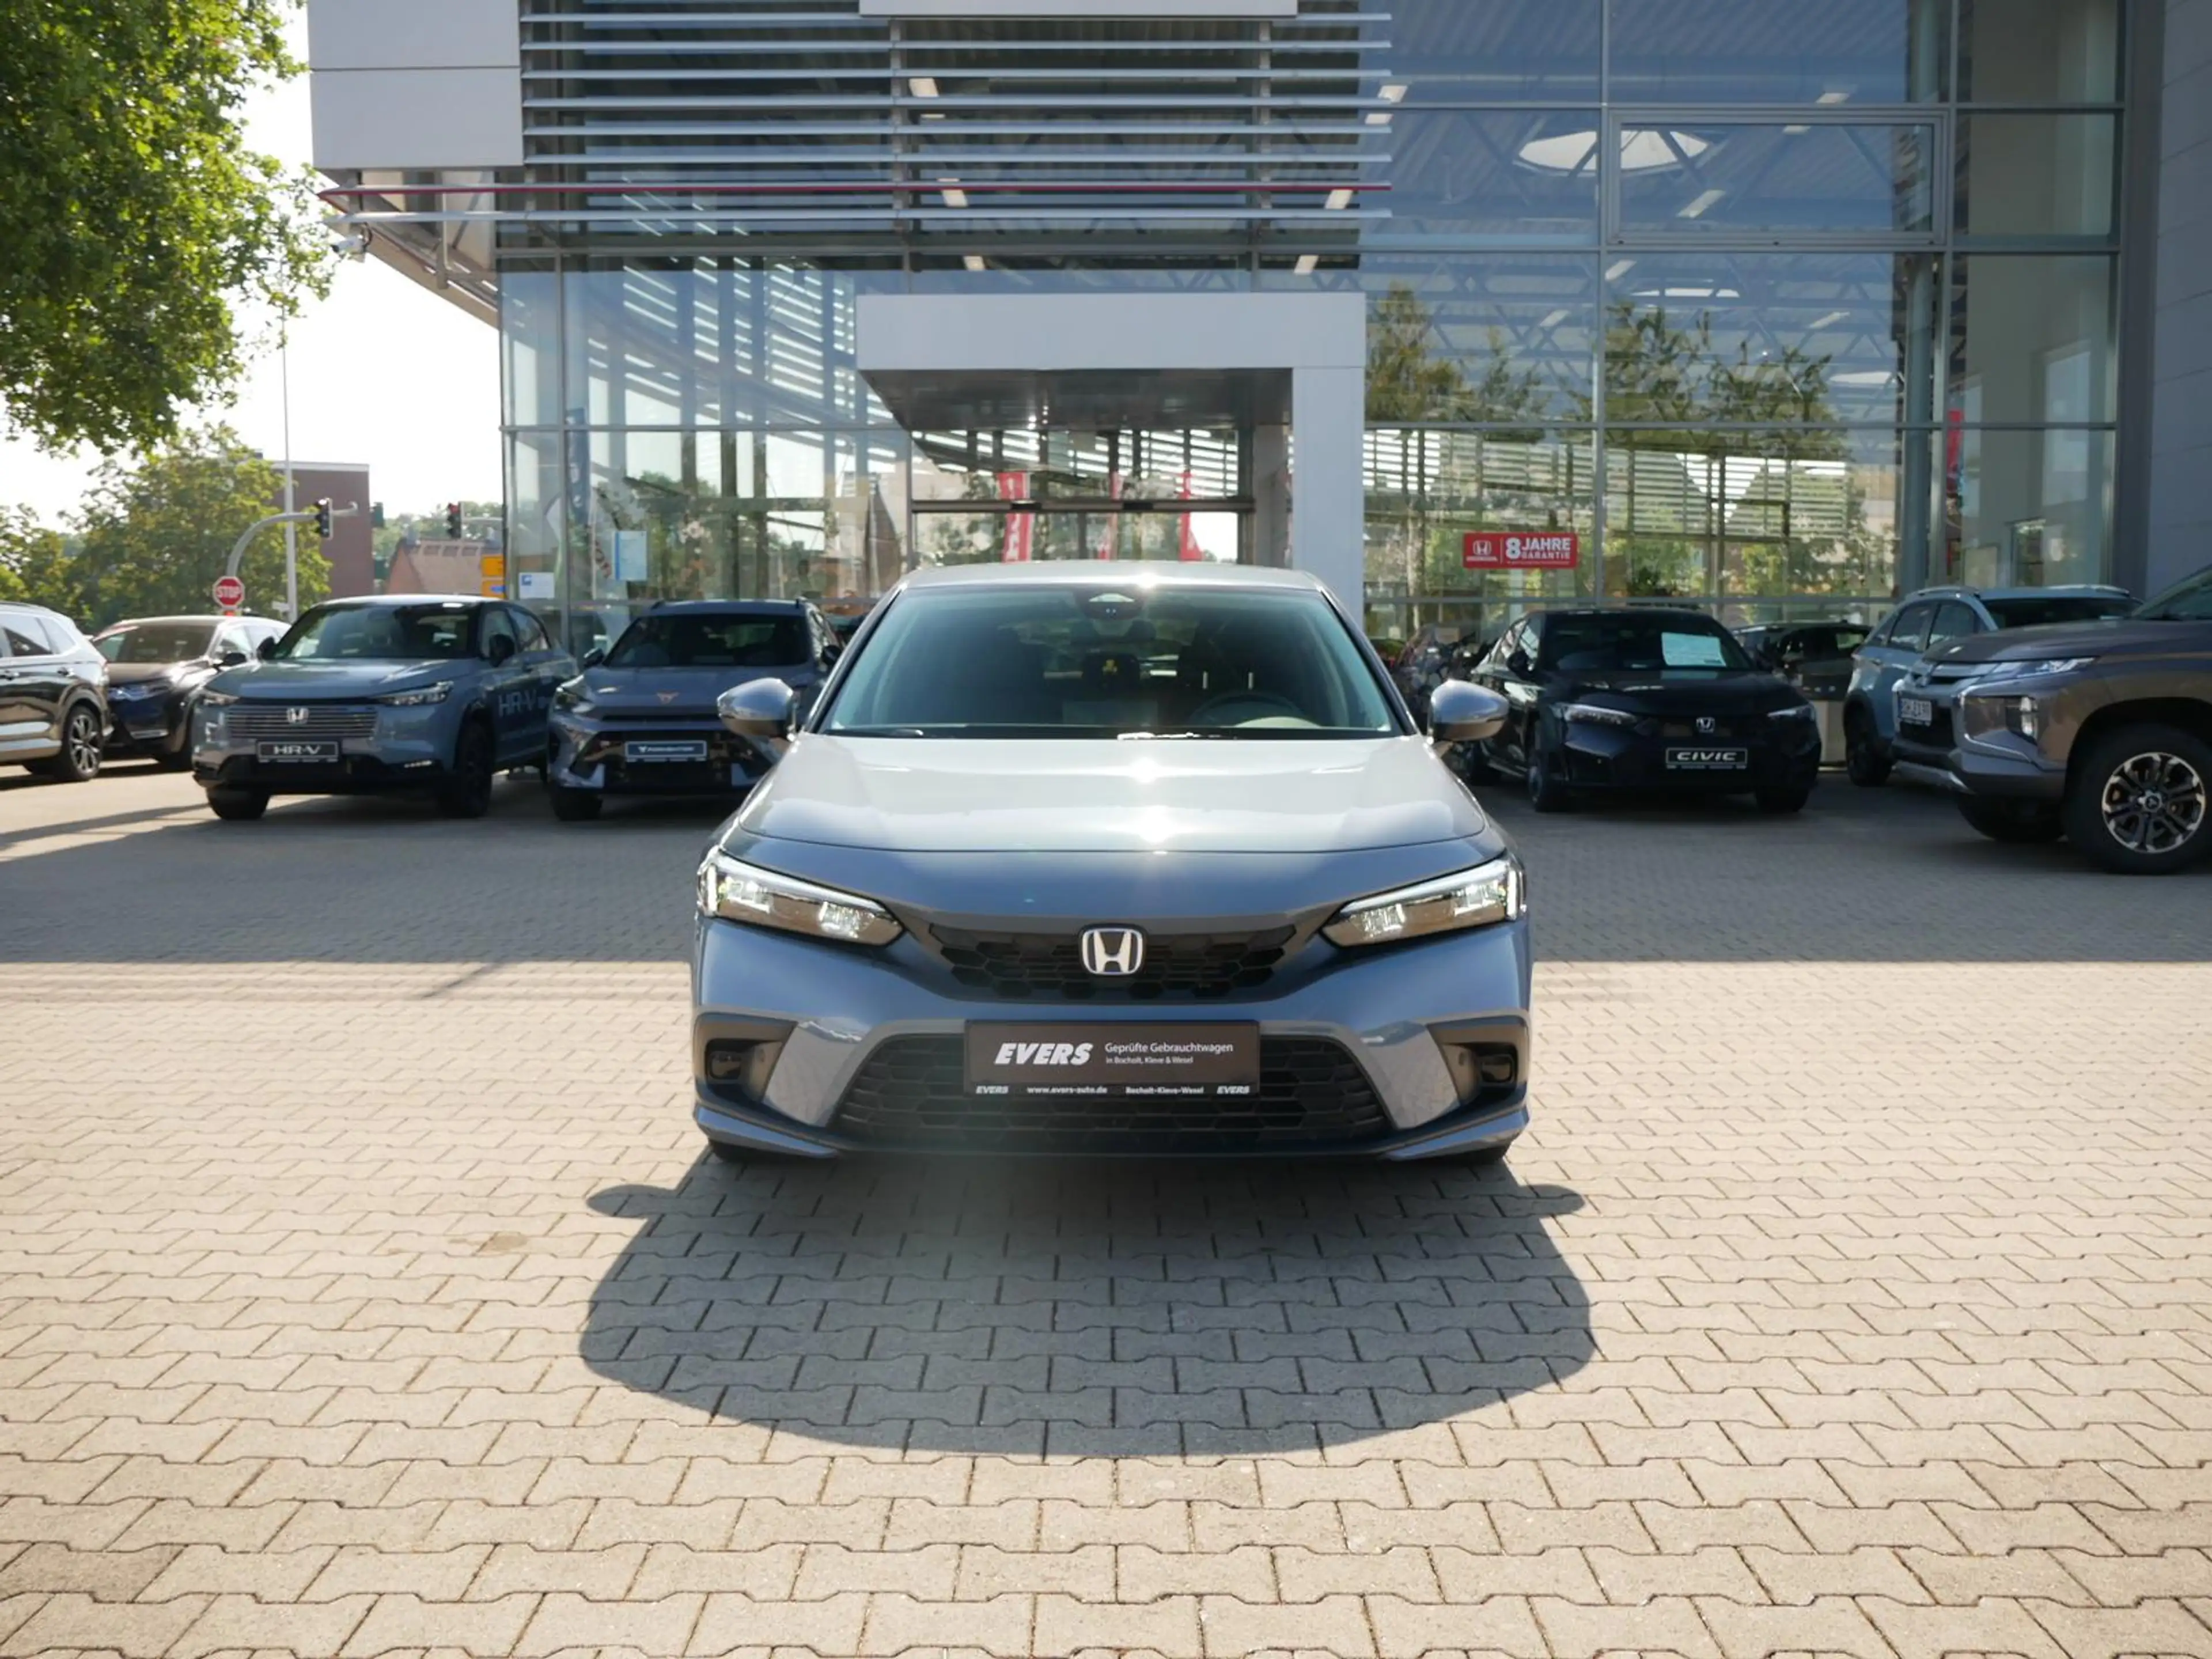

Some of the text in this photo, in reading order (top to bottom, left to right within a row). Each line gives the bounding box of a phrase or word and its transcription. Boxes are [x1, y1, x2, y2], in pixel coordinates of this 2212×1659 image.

[1505, 537, 1571, 559] 8 JAHRE
[1521, 551, 1571, 559] GARANTIE
[216, 586, 241, 599] STOP
[273, 744, 321, 755] HR-V
[1677, 752, 1737, 761] CIVIC
[994, 1043, 1093, 1065] EVERS
[1105, 1042, 1234, 1055] Geprüfte Gebrauchtwagen
[976, 1085, 1009, 1094] EVERS
[1217, 1085, 1250, 1094] EVERS
